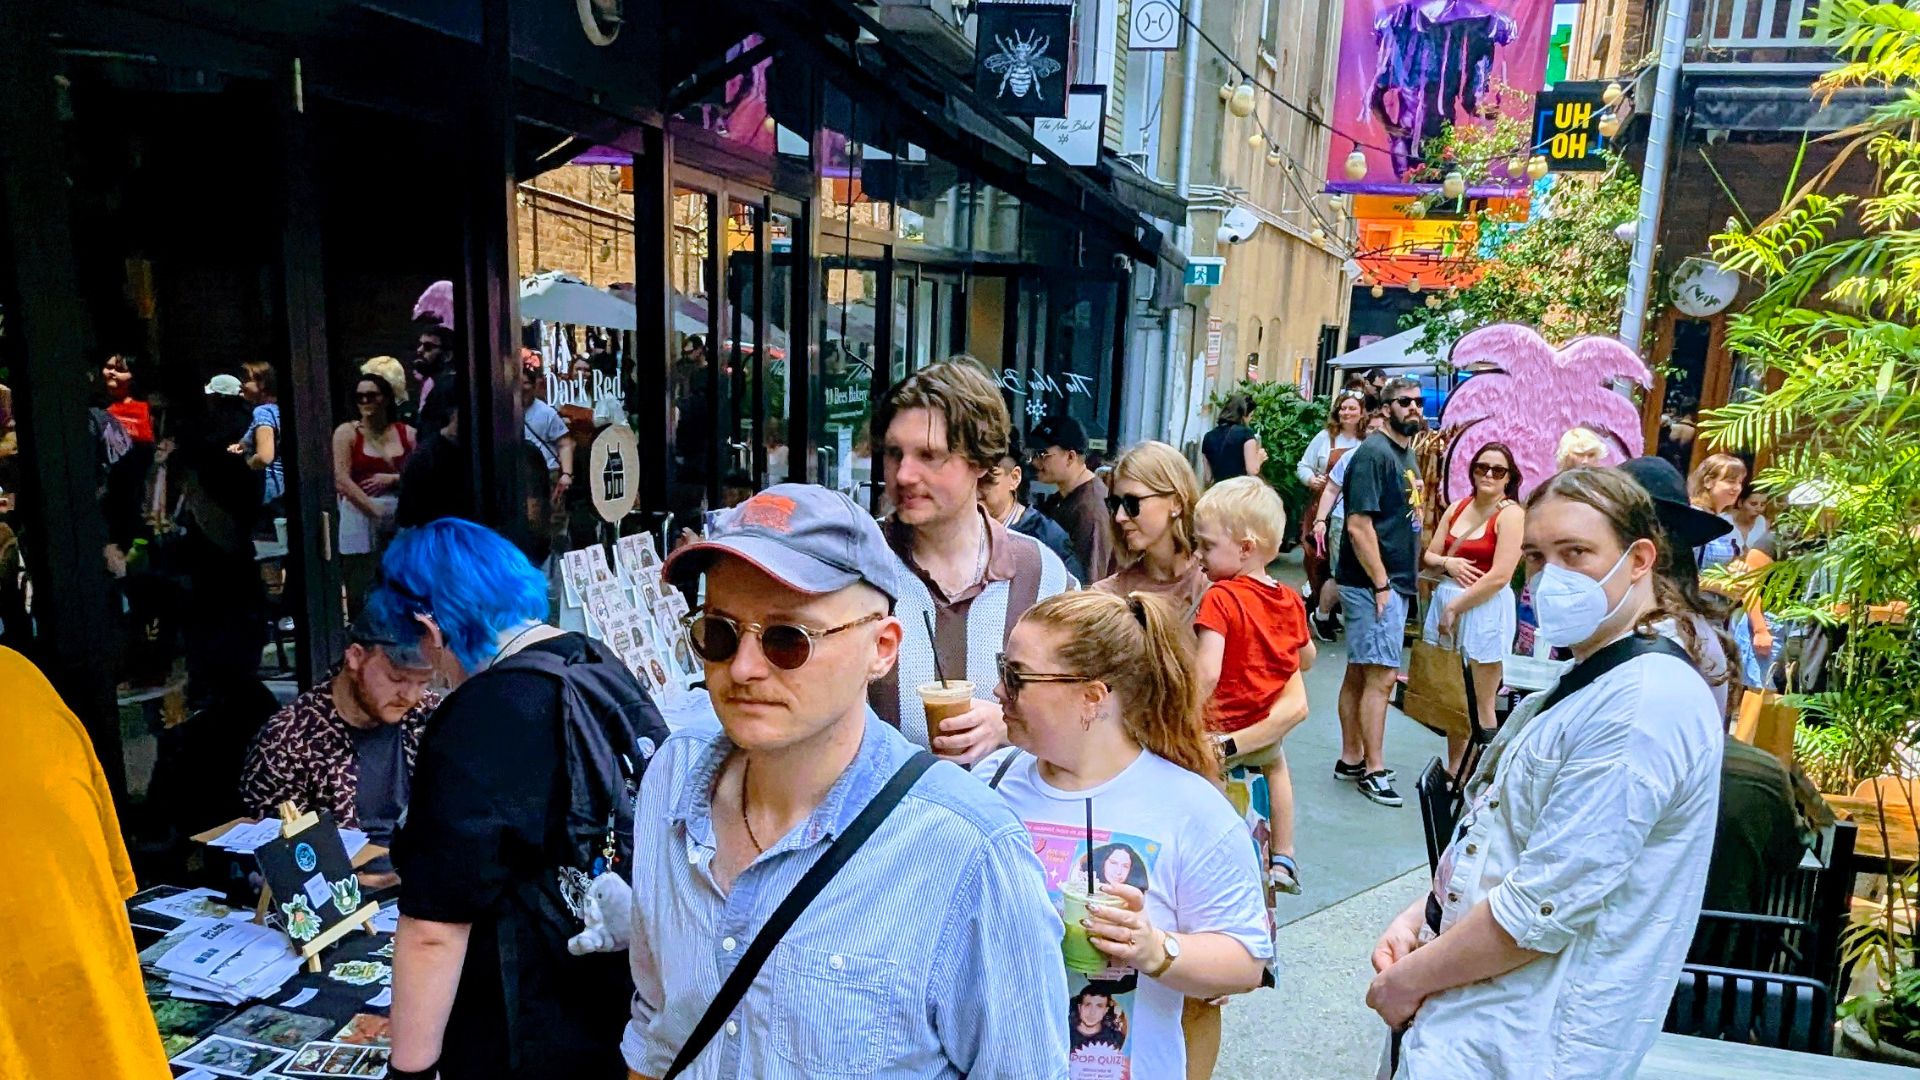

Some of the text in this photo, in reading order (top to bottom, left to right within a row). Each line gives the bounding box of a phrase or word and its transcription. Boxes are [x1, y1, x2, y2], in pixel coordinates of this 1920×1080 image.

[1038, 120, 1051, 131] The
[1555, 102, 1592, 129] UH
[1551, 132, 1587, 159] OH
[545, 367, 626, 407] Dark Red.
[1071, 1053, 1095, 1064] POP
